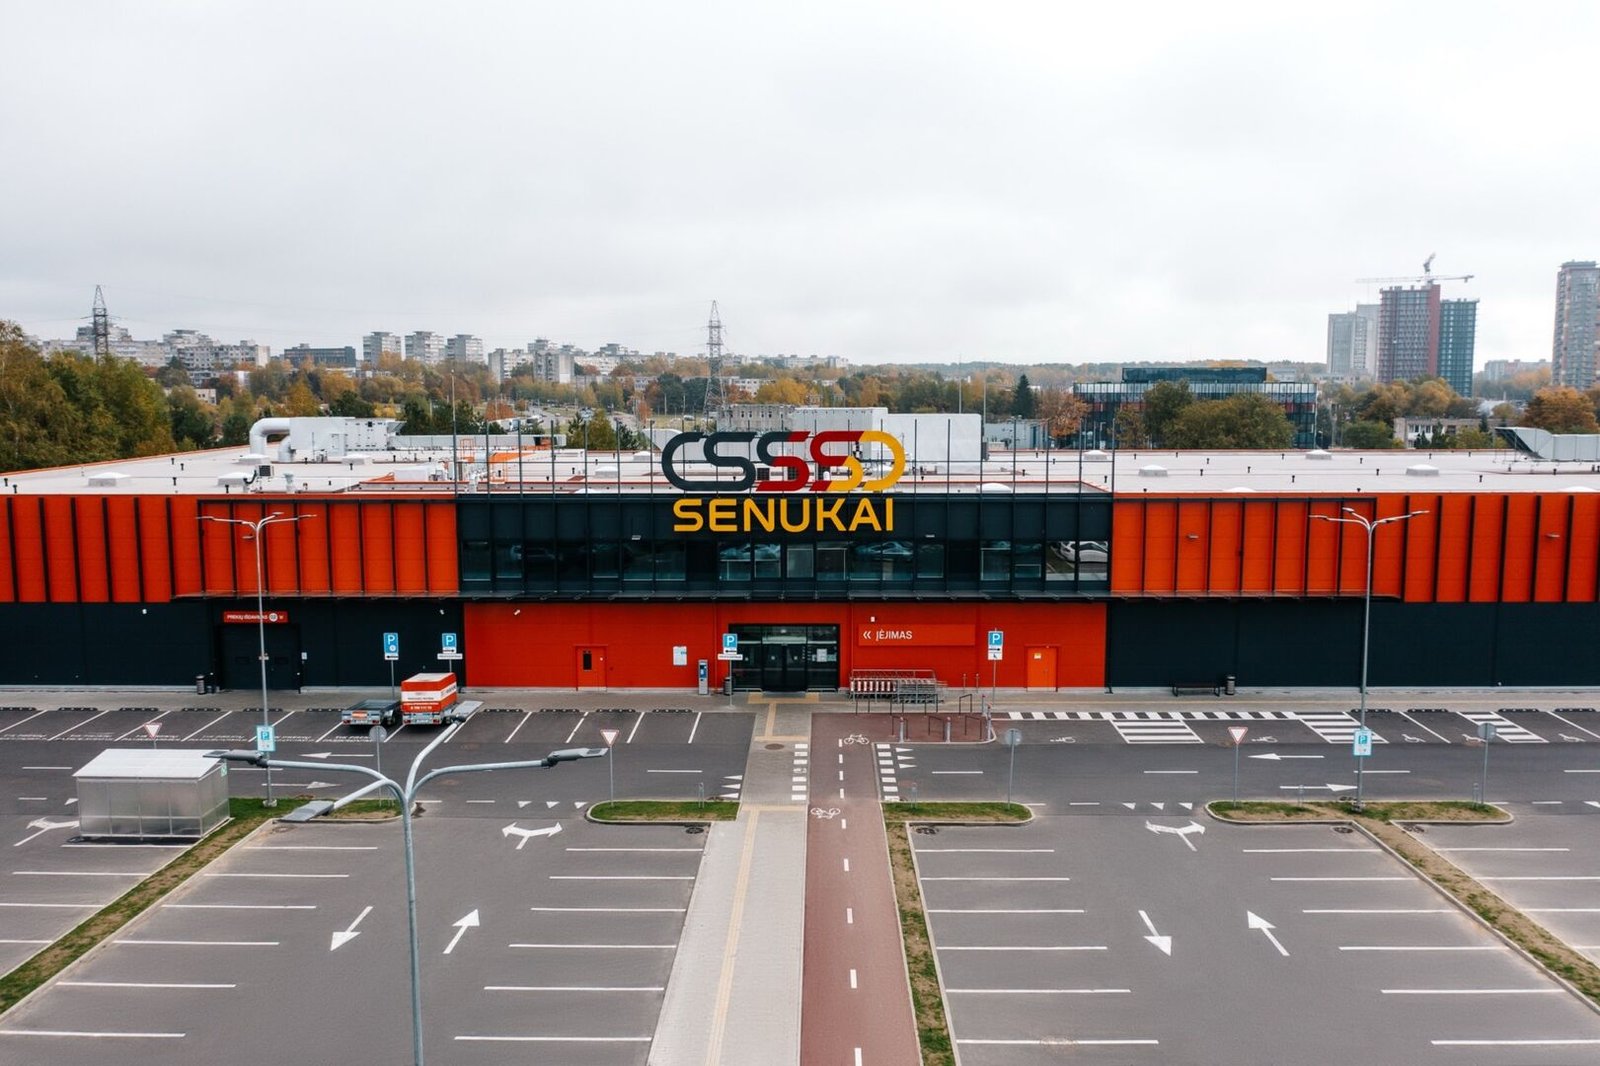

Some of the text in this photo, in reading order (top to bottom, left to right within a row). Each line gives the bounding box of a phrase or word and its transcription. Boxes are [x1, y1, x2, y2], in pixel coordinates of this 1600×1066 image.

[672, 498, 894, 533] SENUKAI
[387, 634, 396, 645] P
[445, 635, 454, 646] P
[727, 635, 735, 647] P
[875, 629, 913, 642] ĮĖJIMAS
[992, 633, 1001, 644] P
